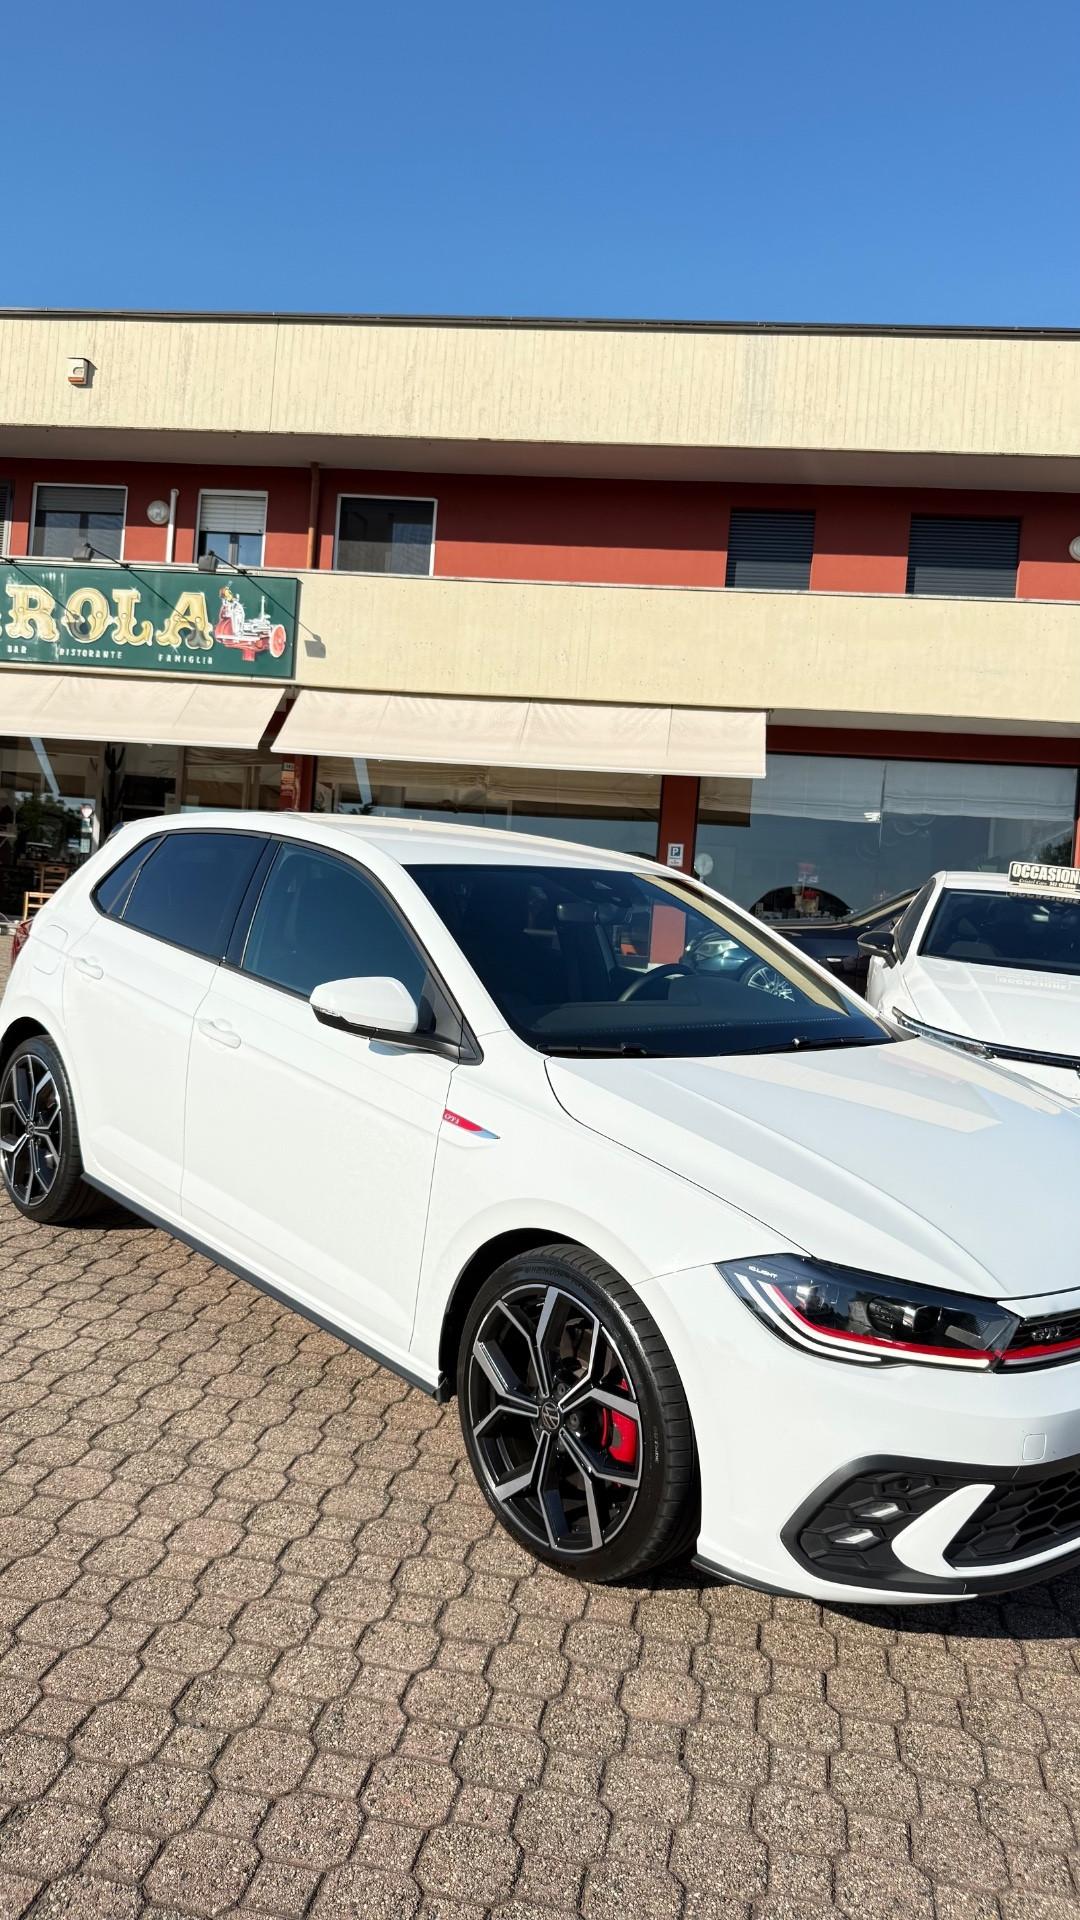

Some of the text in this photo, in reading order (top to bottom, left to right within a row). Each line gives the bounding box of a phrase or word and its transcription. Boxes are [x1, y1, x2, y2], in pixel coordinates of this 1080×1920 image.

[0, 584, 214, 650] ROLA
[7, 645, 213, 665] BAR RISTORANTE FAMIGLIA
